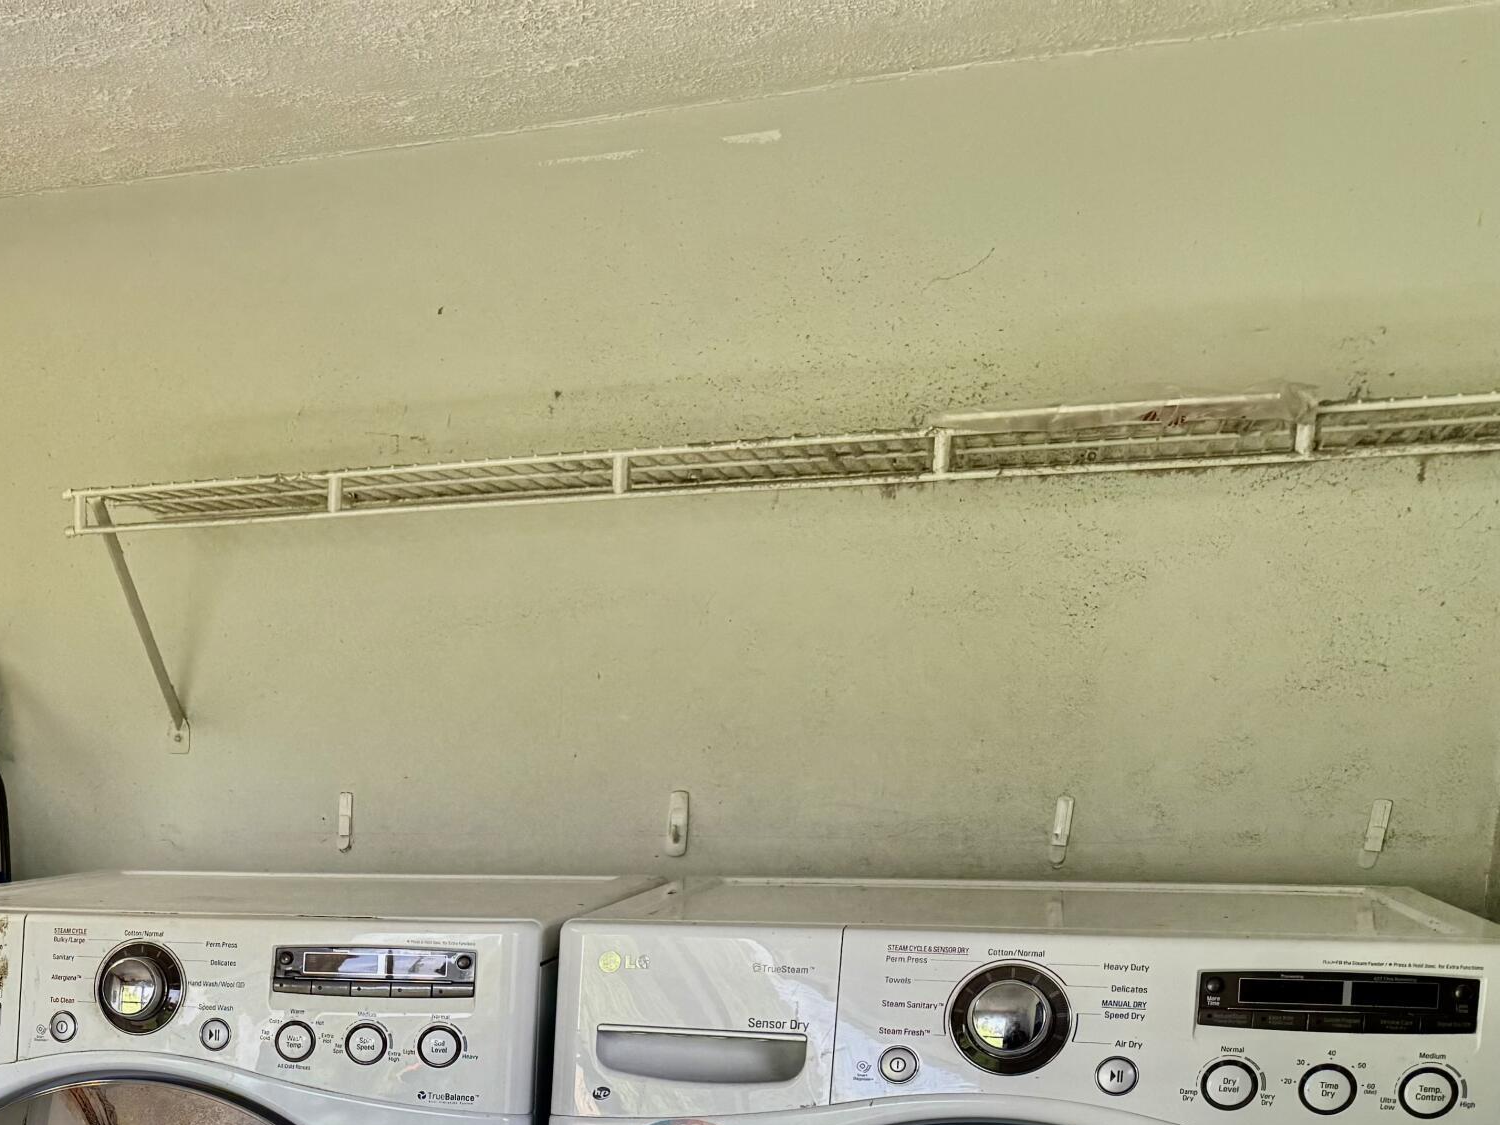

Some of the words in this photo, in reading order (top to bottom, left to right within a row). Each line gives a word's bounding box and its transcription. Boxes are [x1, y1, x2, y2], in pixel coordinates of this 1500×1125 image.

[124, 929, 165, 938] Cotton/Normal
[53, 936, 86, 944] Bulky/Large
[887, 944, 908, 952] STEAM
[908, 945, 928, 953] CYCLE
[987, 948, 1046, 958] Cotton/Normal
[52, 953, 75, 962] Sanitary
[625, 955, 650, 969] LG
[885, 955, 906, 964] Perm
[906, 956, 928, 964] Press
[210, 959, 237, 967] Delicates
[1103, 962, 1129, 972] Heavy
[1130, 963, 1150, 973] Duty
[884, 976, 912, 985] Towels
[1111, 984, 1148, 994] Delicates
[50, 996, 60, 1004] Tub
[881, 1000, 906, 1009] Steam
[1101, 999, 1132, 1008] MANUAL
[1132, 1001, 1148, 1009] DRY
[198, 1003, 217, 1012] Speed
[1104, 1010, 1130, 1020] Speed
[1130, 1012, 1146, 1022] Dry
[748, 1017, 788, 1030] Sensor
[789, 1019, 810, 1032] Dry
[878, 1027, 903, 1036] Steam
[356, 1043, 375, 1052] Speed
[1114, 1039, 1127, 1048] Air
[1128, 1040, 1143, 1050] Dry
[1220, 1046, 1245, 1054] Normal
[1418, 1052, 1447, 1060] Medium
[1222, 1078, 1237, 1086] Dry
[1319, 1081, 1339, 1090] Time
[1179, 1088, 1199, 1097] Damp
[1218, 1085, 1240, 1093] Level
[1418, 1085, 1443, 1095] Temp.
[1182, 1094, 1195, 1102] Dry
[1260, 1093, 1276, 1101] Very
[1321, 1089, 1336, 1099] Dry
[1415, 1093, 1446, 1102] Control
[1261, 1099, 1274, 1107] Dry
[1459, 1101, 1476, 1110] High
